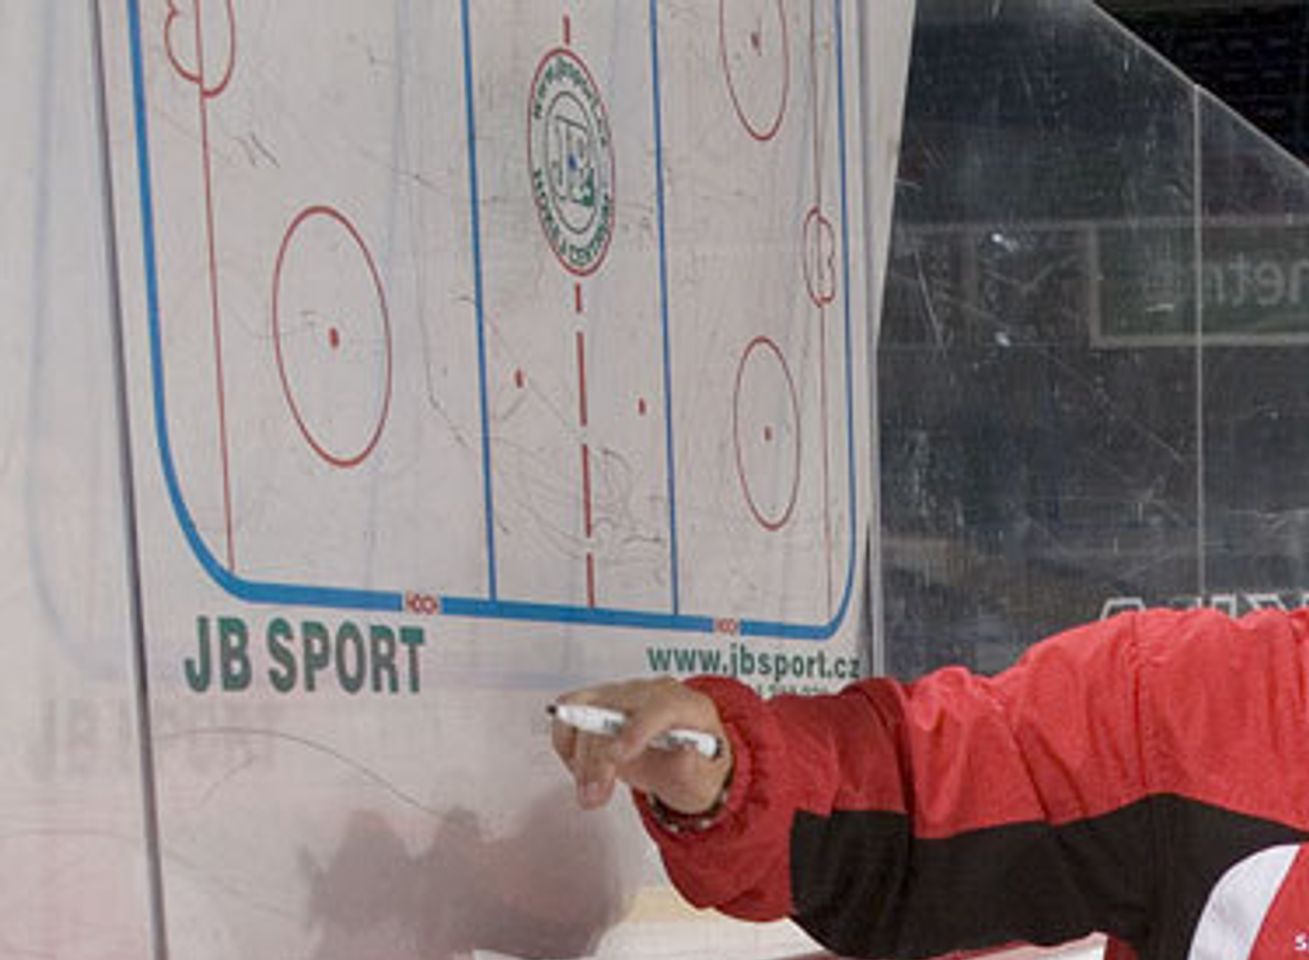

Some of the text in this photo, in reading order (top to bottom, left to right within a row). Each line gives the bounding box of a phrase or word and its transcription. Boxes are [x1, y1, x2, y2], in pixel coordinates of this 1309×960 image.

[183, 615, 425, 695] JB SPORT
[646, 643, 861, 682] www.jbsport.cz
